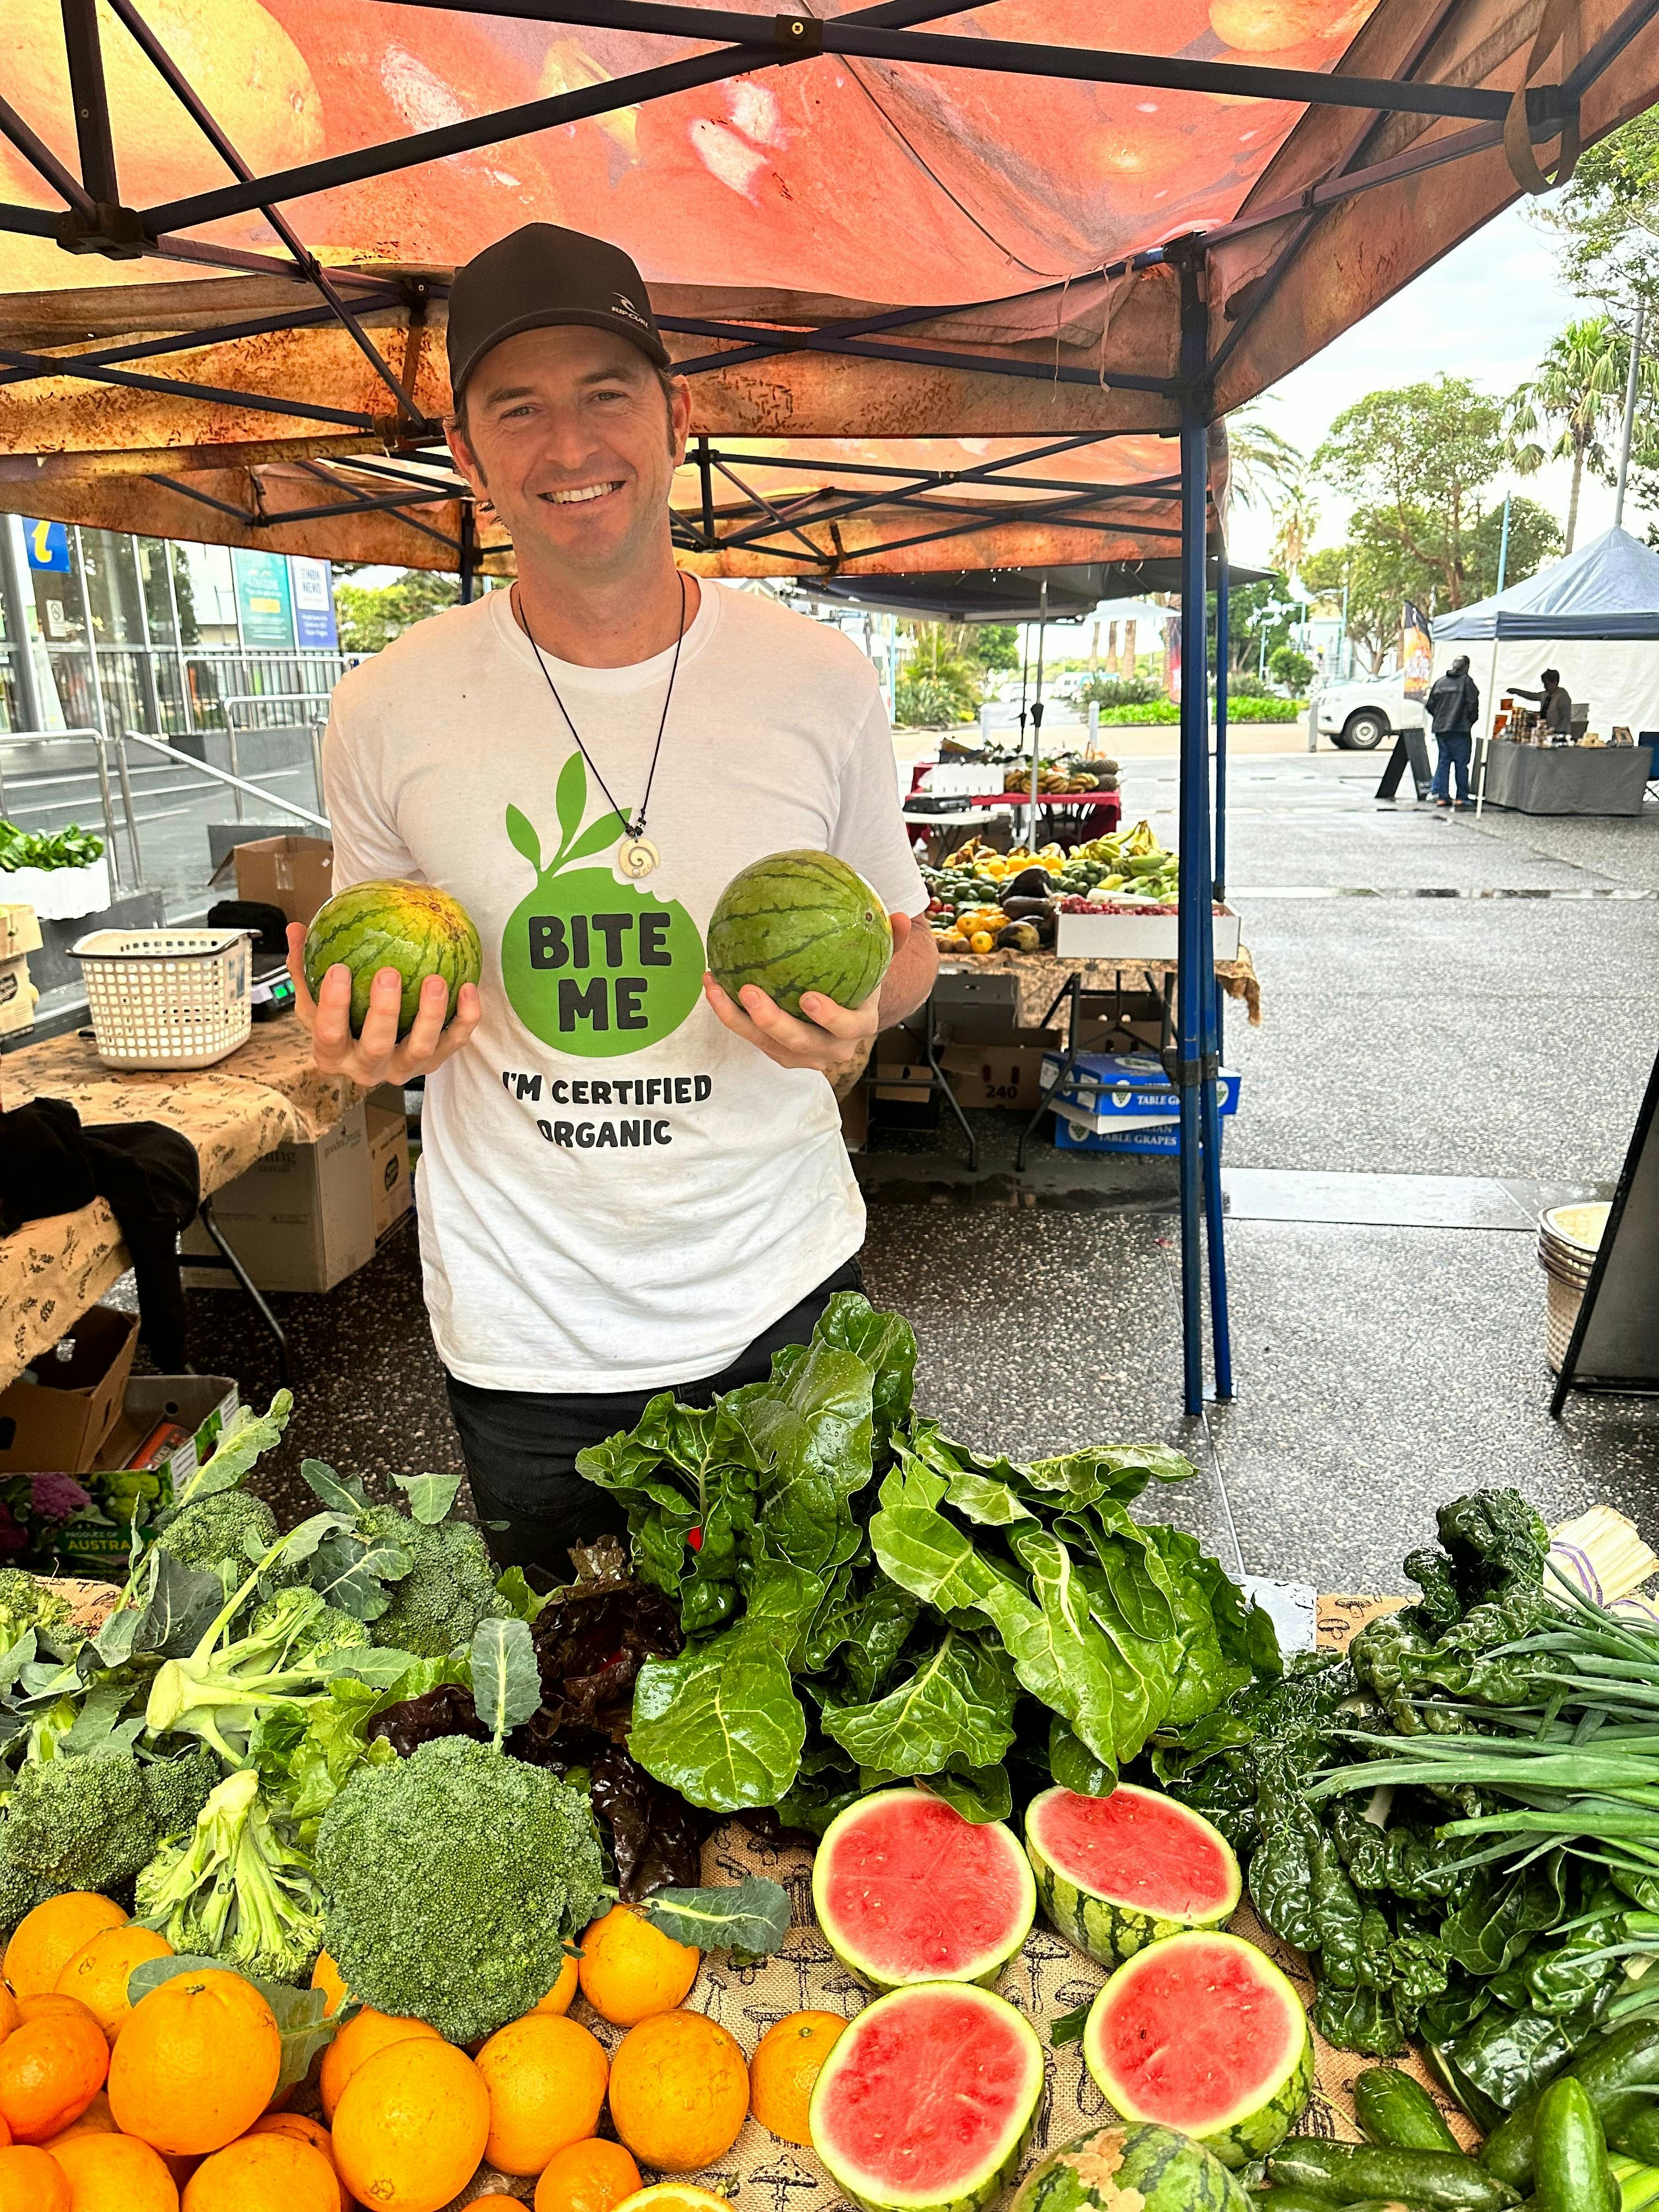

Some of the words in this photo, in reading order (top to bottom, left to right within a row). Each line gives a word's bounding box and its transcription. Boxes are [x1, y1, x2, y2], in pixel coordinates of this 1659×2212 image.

[612, 306, 628, 315] RIP
[628, 313, 649, 329] CURL
[303, 582, 322, 595] NEWS
[528, 912, 672, 970] BITE
[558, 977, 649, 1032] ME
[502, 1071, 542, 1102] I'M
[552, 1074, 712, 1105] CERTIFIED
[986, 1085, 1018, 1098] 240
[1137, 1095, 1167, 1105] TABLE
[536, 1119, 673, 1148] ORGANIC
[1099, 1133, 1131, 1143] TABLE
[1133, 1134, 1177, 1147] GRAPES
[68, 1539, 155, 1551] AUSTRAA
